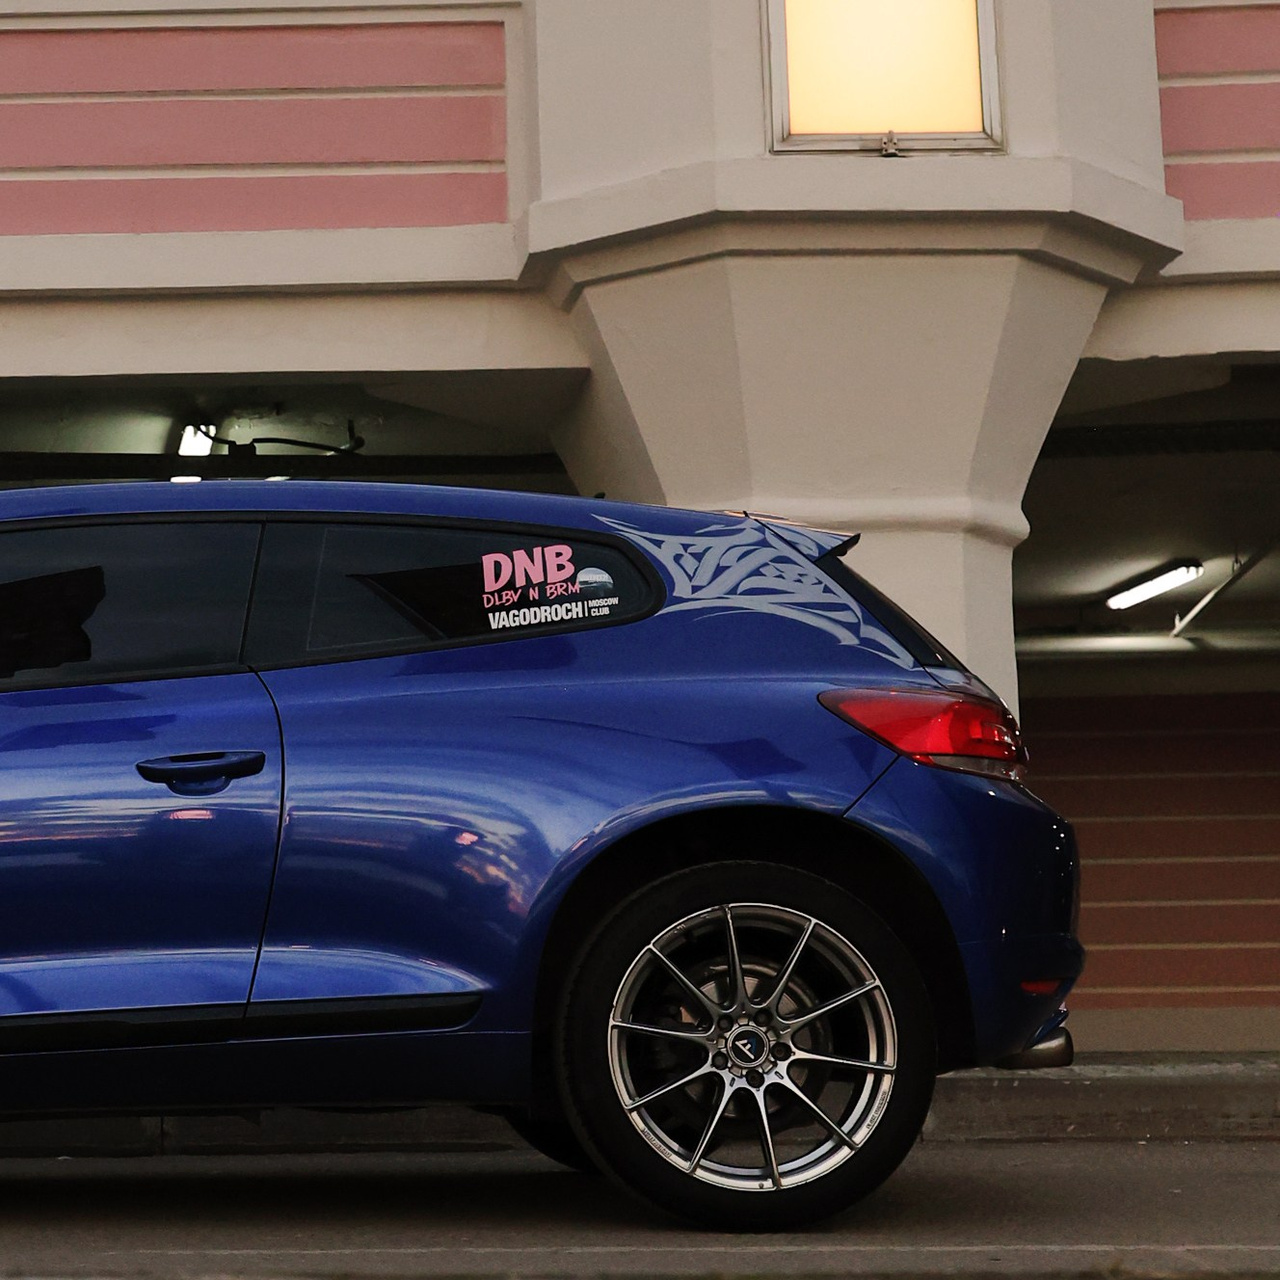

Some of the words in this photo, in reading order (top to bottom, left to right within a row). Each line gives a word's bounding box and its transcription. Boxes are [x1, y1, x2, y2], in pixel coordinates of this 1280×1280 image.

[482, 544, 575, 593] DNB
[529, 586, 539, 601] N
[545, 582, 580, 600] BRM
[588, 597, 619, 608] MOSCOW
[590, 606, 610, 617] CLUB
[488, 601, 583, 630] VAGODROCH
